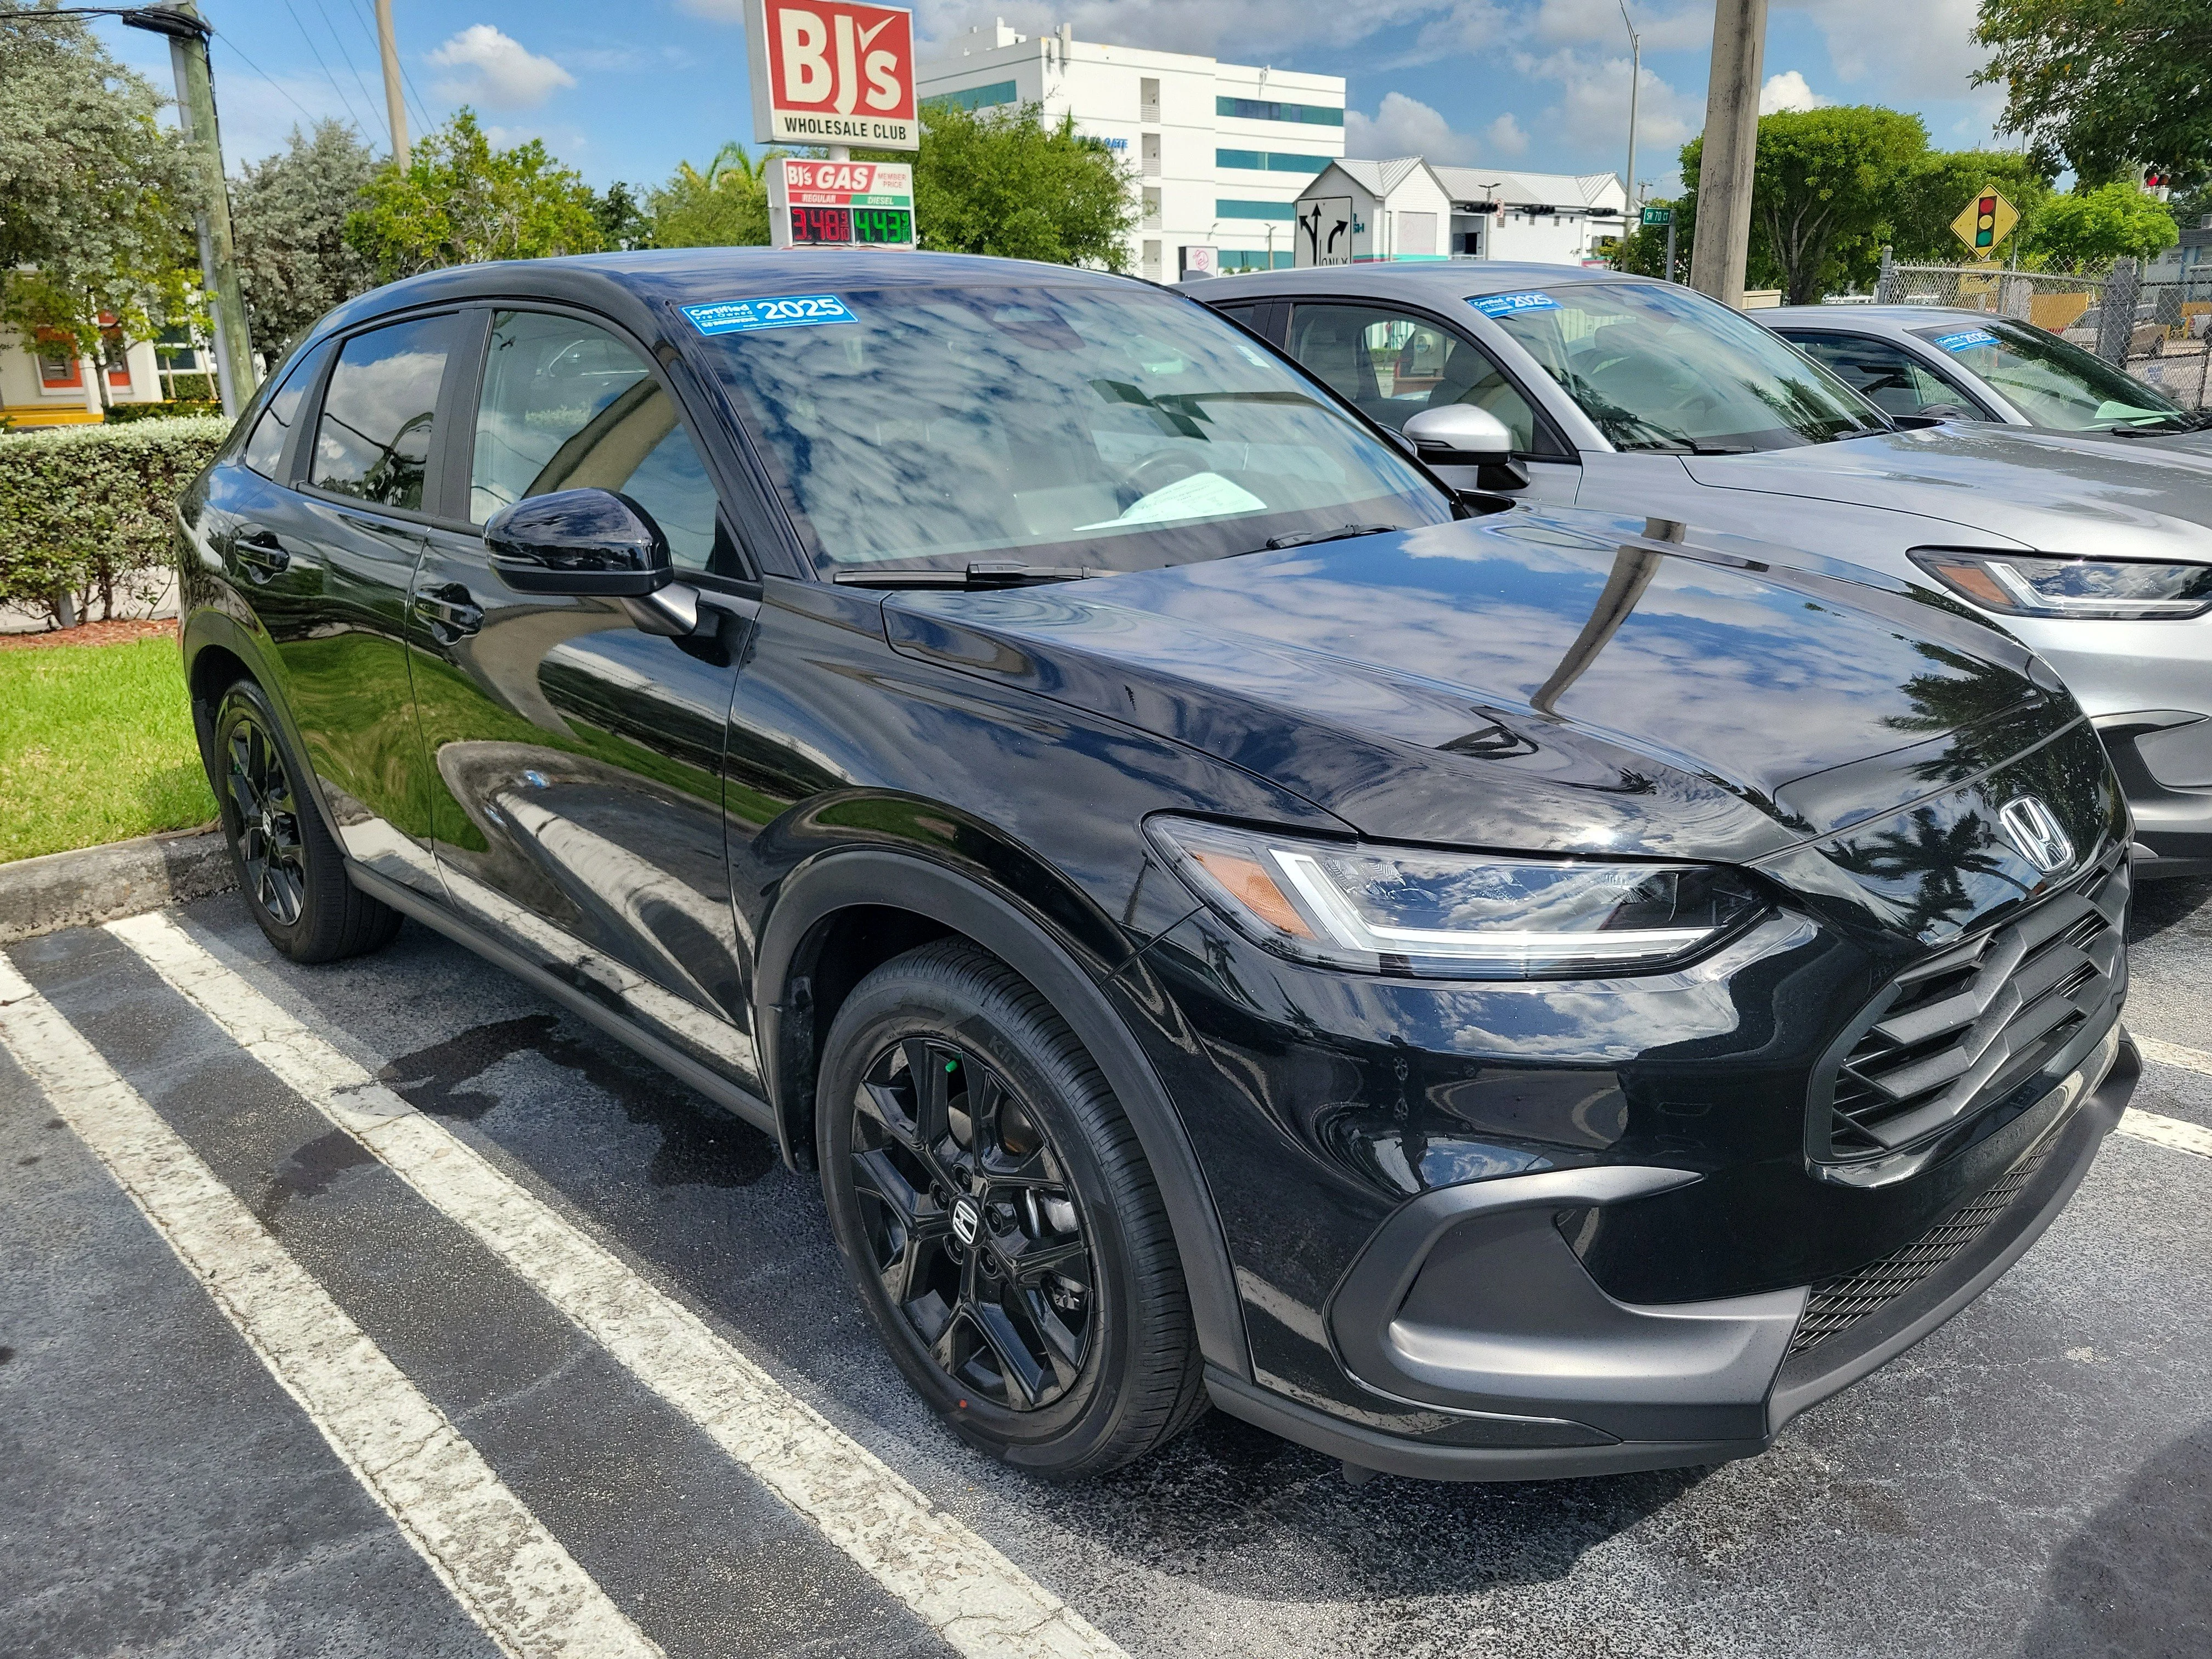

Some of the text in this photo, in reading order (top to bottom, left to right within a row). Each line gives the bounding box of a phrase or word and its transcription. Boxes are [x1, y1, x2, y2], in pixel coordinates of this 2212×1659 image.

[784, 117, 906, 140] WHOLESALE CLUB
[815, 165, 869, 190] GAS
[878, 172, 907, 181] MEMBER
[883, 180, 903, 189] PRICE
[802, 193, 837, 204] REGULAR
[867, 196, 894, 206] DIESEL
[1506, 295, 1553, 308] 2025
[690, 303, 750, 317] Certified
[757, 298, 844, 320] 2025
